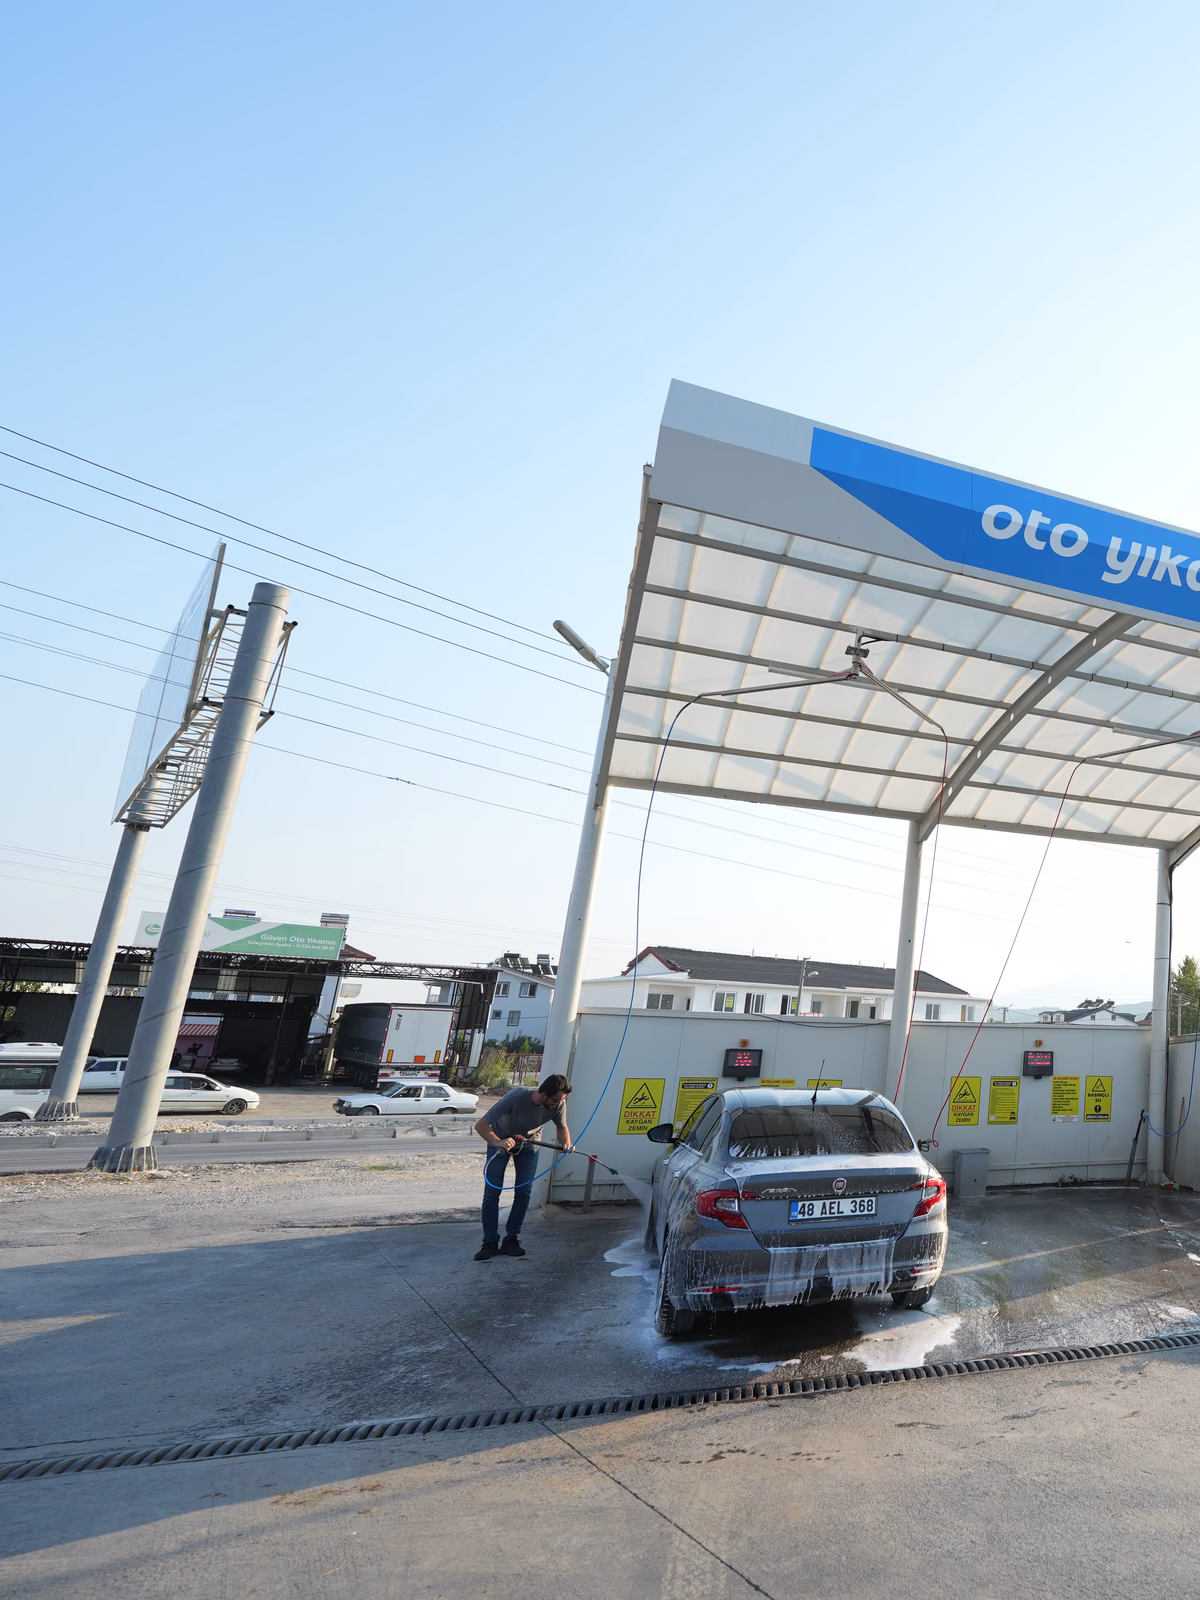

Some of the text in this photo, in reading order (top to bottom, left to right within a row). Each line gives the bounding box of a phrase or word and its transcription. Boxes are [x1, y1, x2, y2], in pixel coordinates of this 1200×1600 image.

[981, 503, 1089, 558] oto
[260, 933, 336, 946] Güven Oto Yıkama
[623, 1109, 657, 1118] DİKKAT
[798, 1203, 815, 1217] 48
[820, 1201, 844, 1216] AEL
[850, 1198, 874, 1214] 368
